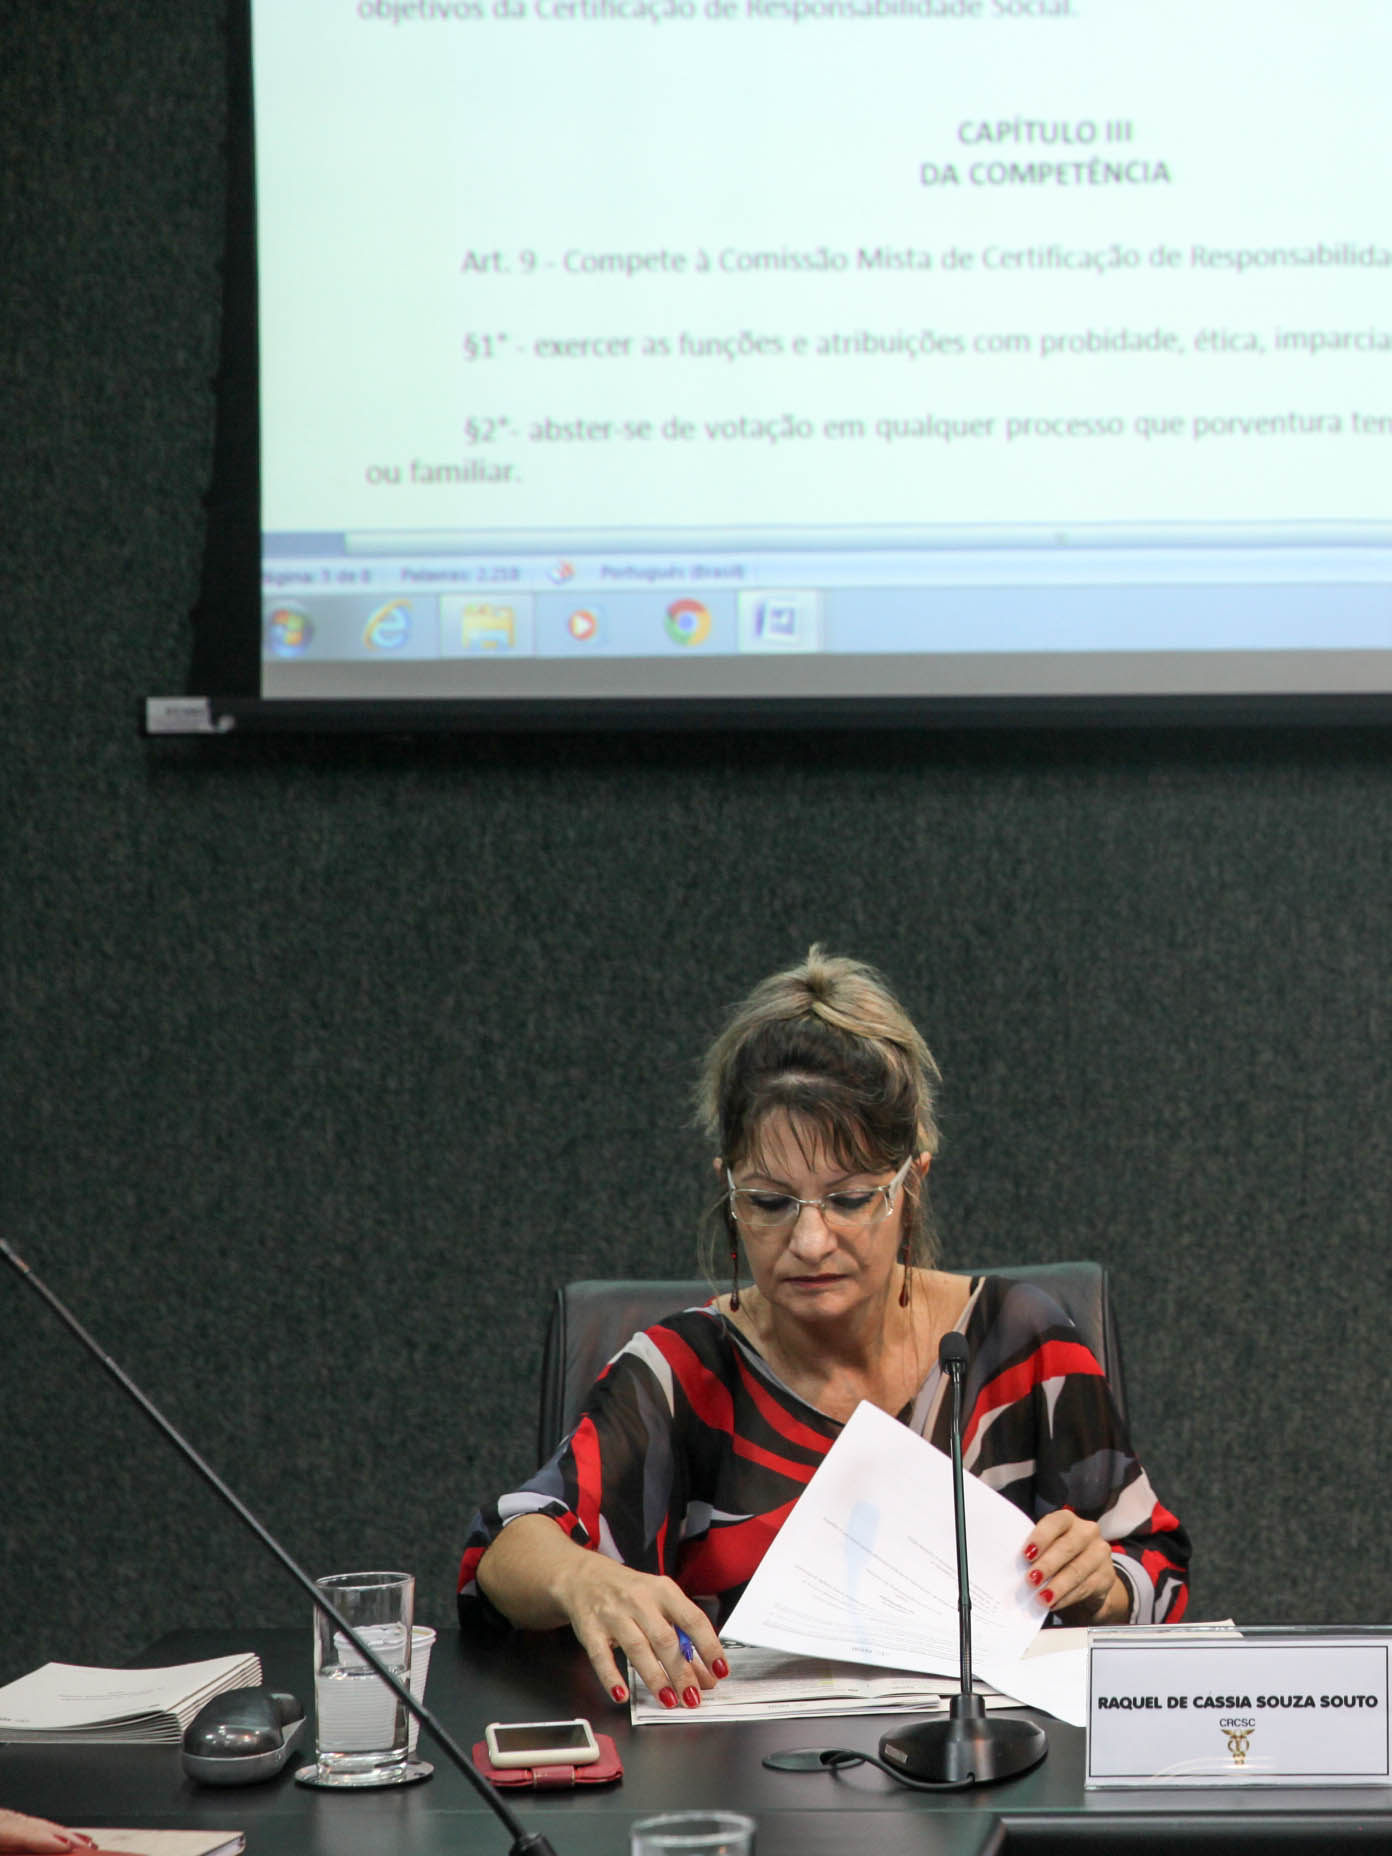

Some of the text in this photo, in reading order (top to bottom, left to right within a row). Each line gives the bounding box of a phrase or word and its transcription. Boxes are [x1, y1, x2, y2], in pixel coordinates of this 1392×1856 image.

[356, 0, 486, 27] objetivos
[491, 0, 527, 20] da
[533, 0, 698, 25] Certificação
[703, 0, 740, 21] de
[745, 0, 985, 25] Responsabilidade
[956, 117, 1133, 146] CAPÍTULO III
[919, 155, 1172, 187] DA COMPETÊNCIA
[460, 249, 511, 275] Art.
[519, 248, 538, 274] 9
[562, 248, 688, 281] Compete
[695, 247, 712, 274] à
[717, 245, 850, 273] Comissão
[855, 245, 933, 271] Mista
[940, 245, 975, 271] de
[981, 243, 1142, 276] Certificação
[1147, 242, 1183, 268] de
[532, 335, 634, 359] exercer
[641, 335, 672, 357] as
[678, 329, 785, 364] funções
[791, 335, 809, 356] e
[815, 329, 967, 364] atribuições
[972, 333, 1032, 354] com
[1039, 327, 1186, 359] probidade,
[1193, 328, 1267, 355] ética,
[527, 415, 654, 443] abster-se
[660, 415, 697, 441] de
[703, 412, 815, 446] votação
[822, 418, 867, 440] em
[874, 413, 996, 447] qualquer
[1005, 416, 1126, 445] processo
[1133, 415, 1186, 443] que
[1192, 411, 1343, 441] porventura
[364, 458, 522, 486] ou familiar.
[1098, 1696, 1162, 1710] RAQUEL
[1167, 1696, 1188, 1709] DE
[1256, 1696, 1316, 1708] SOUZA
[1320, 1695, 1379, 1708] SOUTO
[1219, 1718, 1256, 1728] CRCSC
